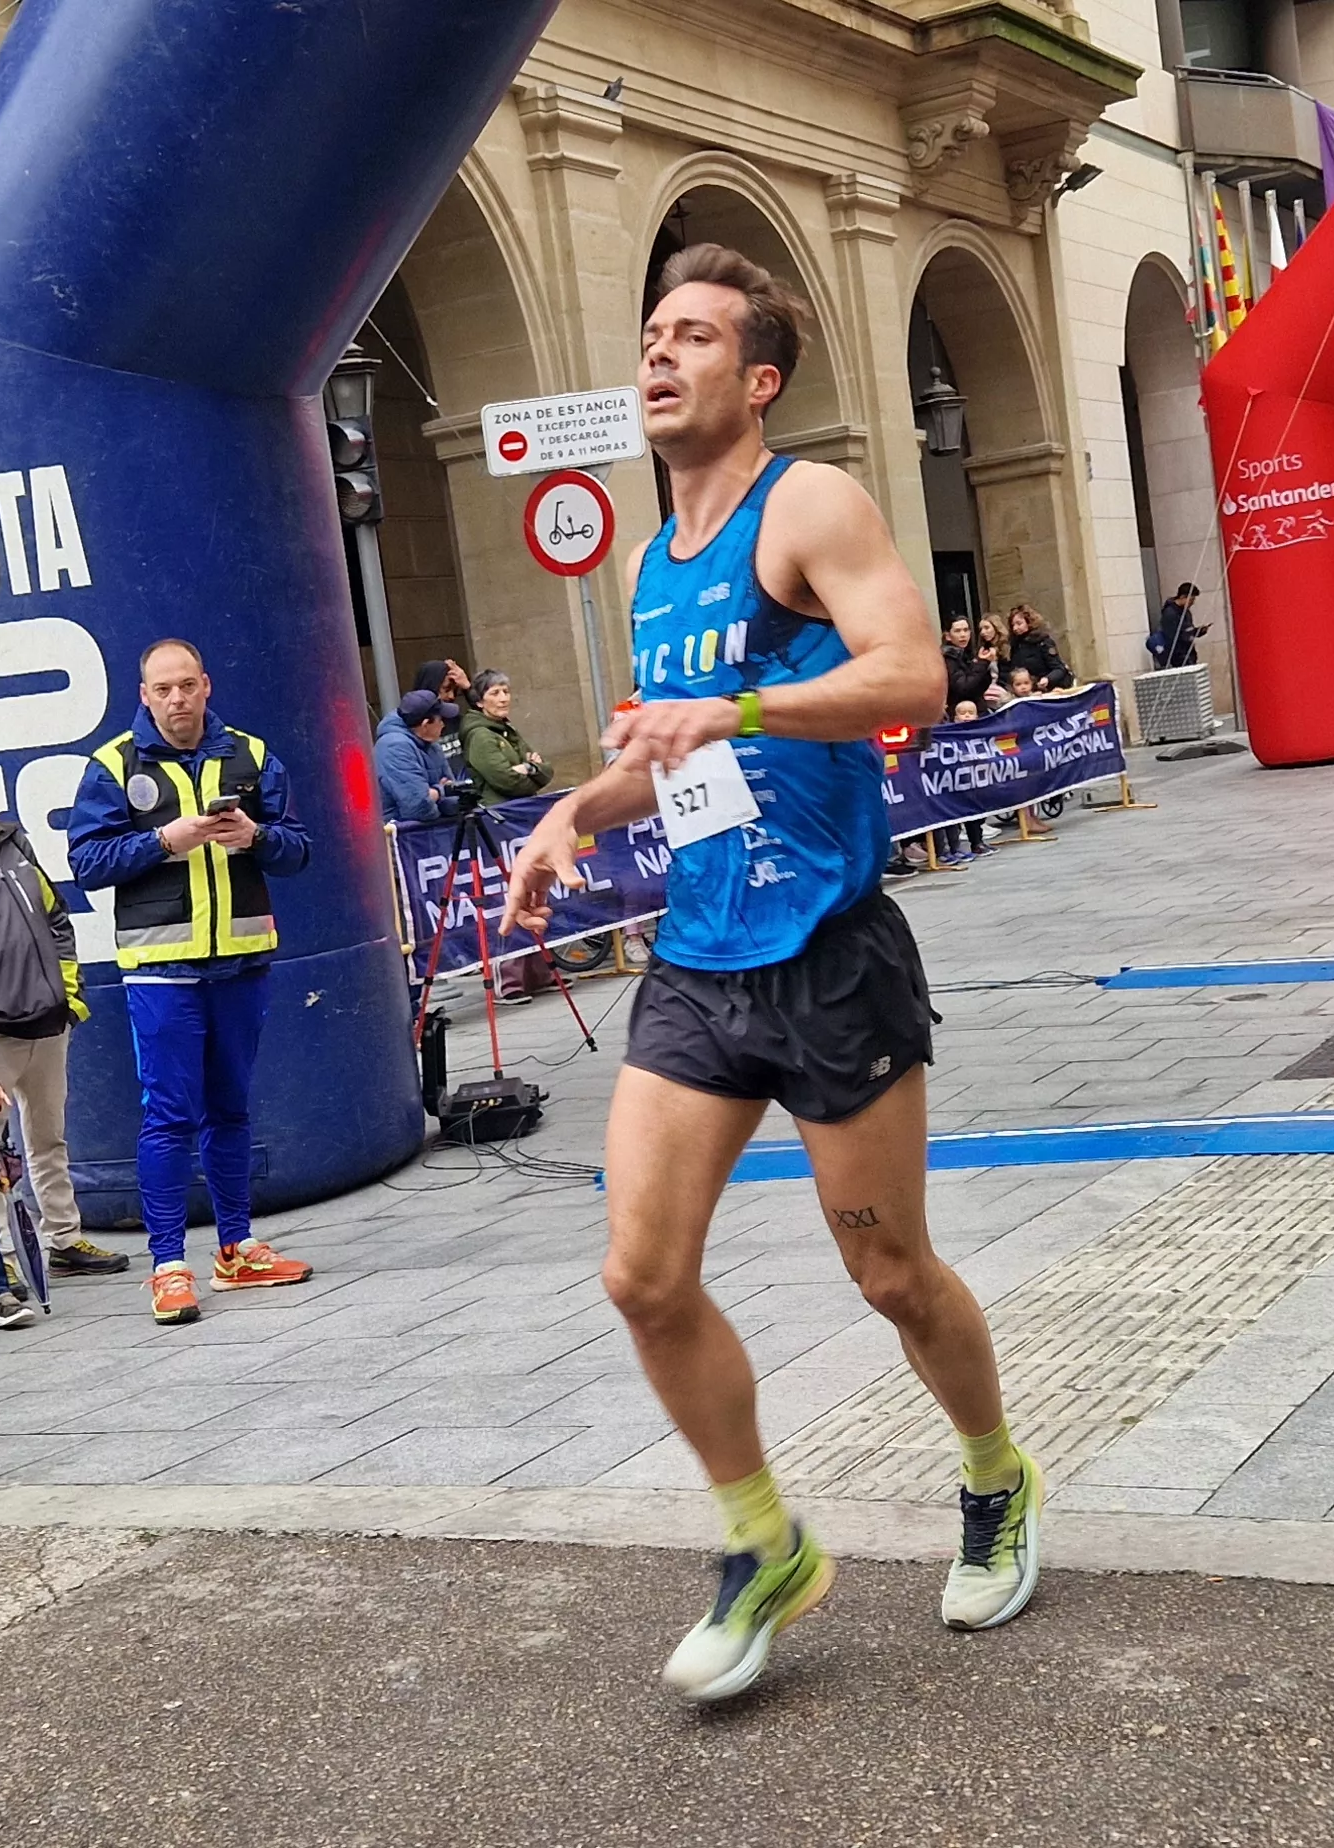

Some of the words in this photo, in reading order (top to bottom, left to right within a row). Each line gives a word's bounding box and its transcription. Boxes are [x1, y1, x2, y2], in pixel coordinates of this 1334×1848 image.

[494, 411, 532, 425] ZONA
[536, 408, 553, 419] DE
[558, 398, 628, 416] ESTANCIA
[537, 419, 586, 433] EXCEPTO
[590, 413, 629, 426] CARGA
[539, 437, 545, 446] Y
[549, 429, 609, 445] DESCARGA
[540, 452, 554, 461] DE
[567, 449, 575, 457] A
[578, 447, 587, 456] 11
[589, 441, 628, 455] HORAS
[1237, 453, 1303, 481] Sports
[921, 757, 1028, 797] NACIONAL
[671, 783, 709, 817] 527
